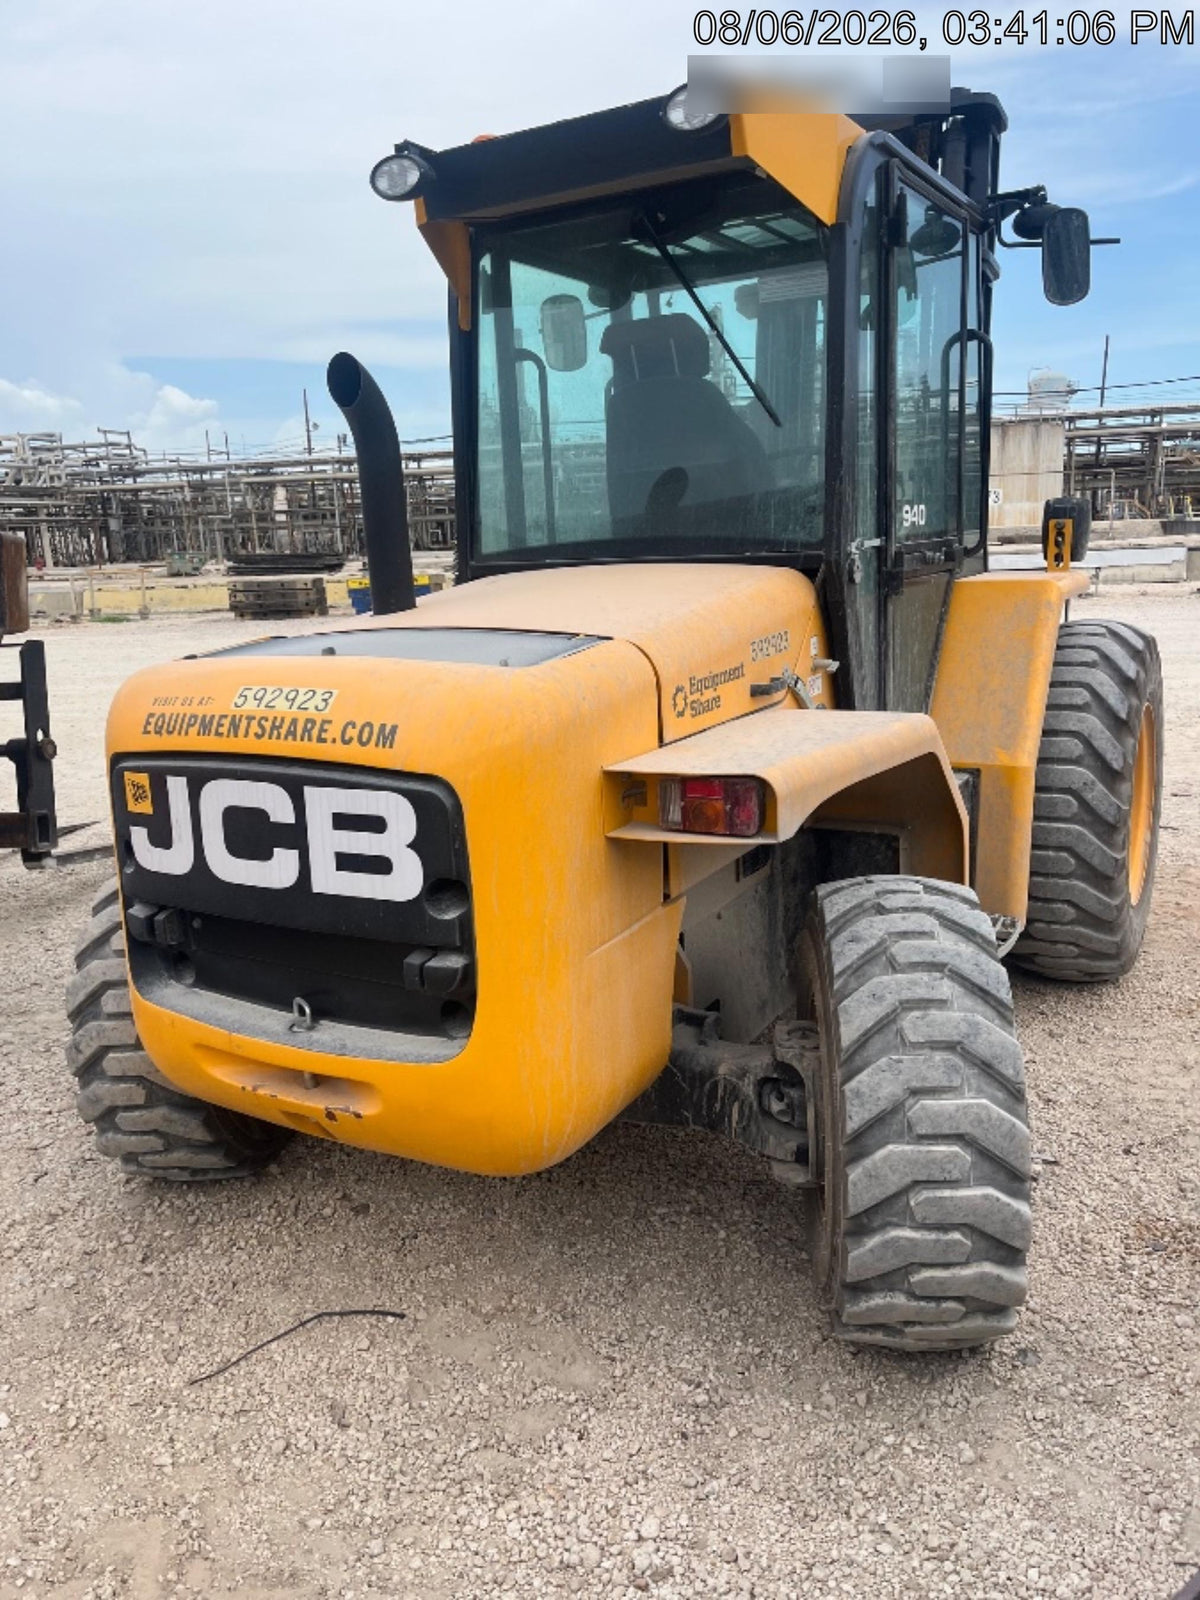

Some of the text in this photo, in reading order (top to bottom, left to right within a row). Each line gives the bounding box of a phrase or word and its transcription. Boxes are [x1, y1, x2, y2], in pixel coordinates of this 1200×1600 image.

[902, 504, 926, 527] 940
[689, 662, 746, 697] Equipment
[152, 696, 177, 707] VISIT
[233, 687, 334, 712] 592923
[689, 694, 721, 718] Share
[142, 712, 399, 749] EQUIPMENTSHARE.COM
[129, 774, 425, 902] JCB
